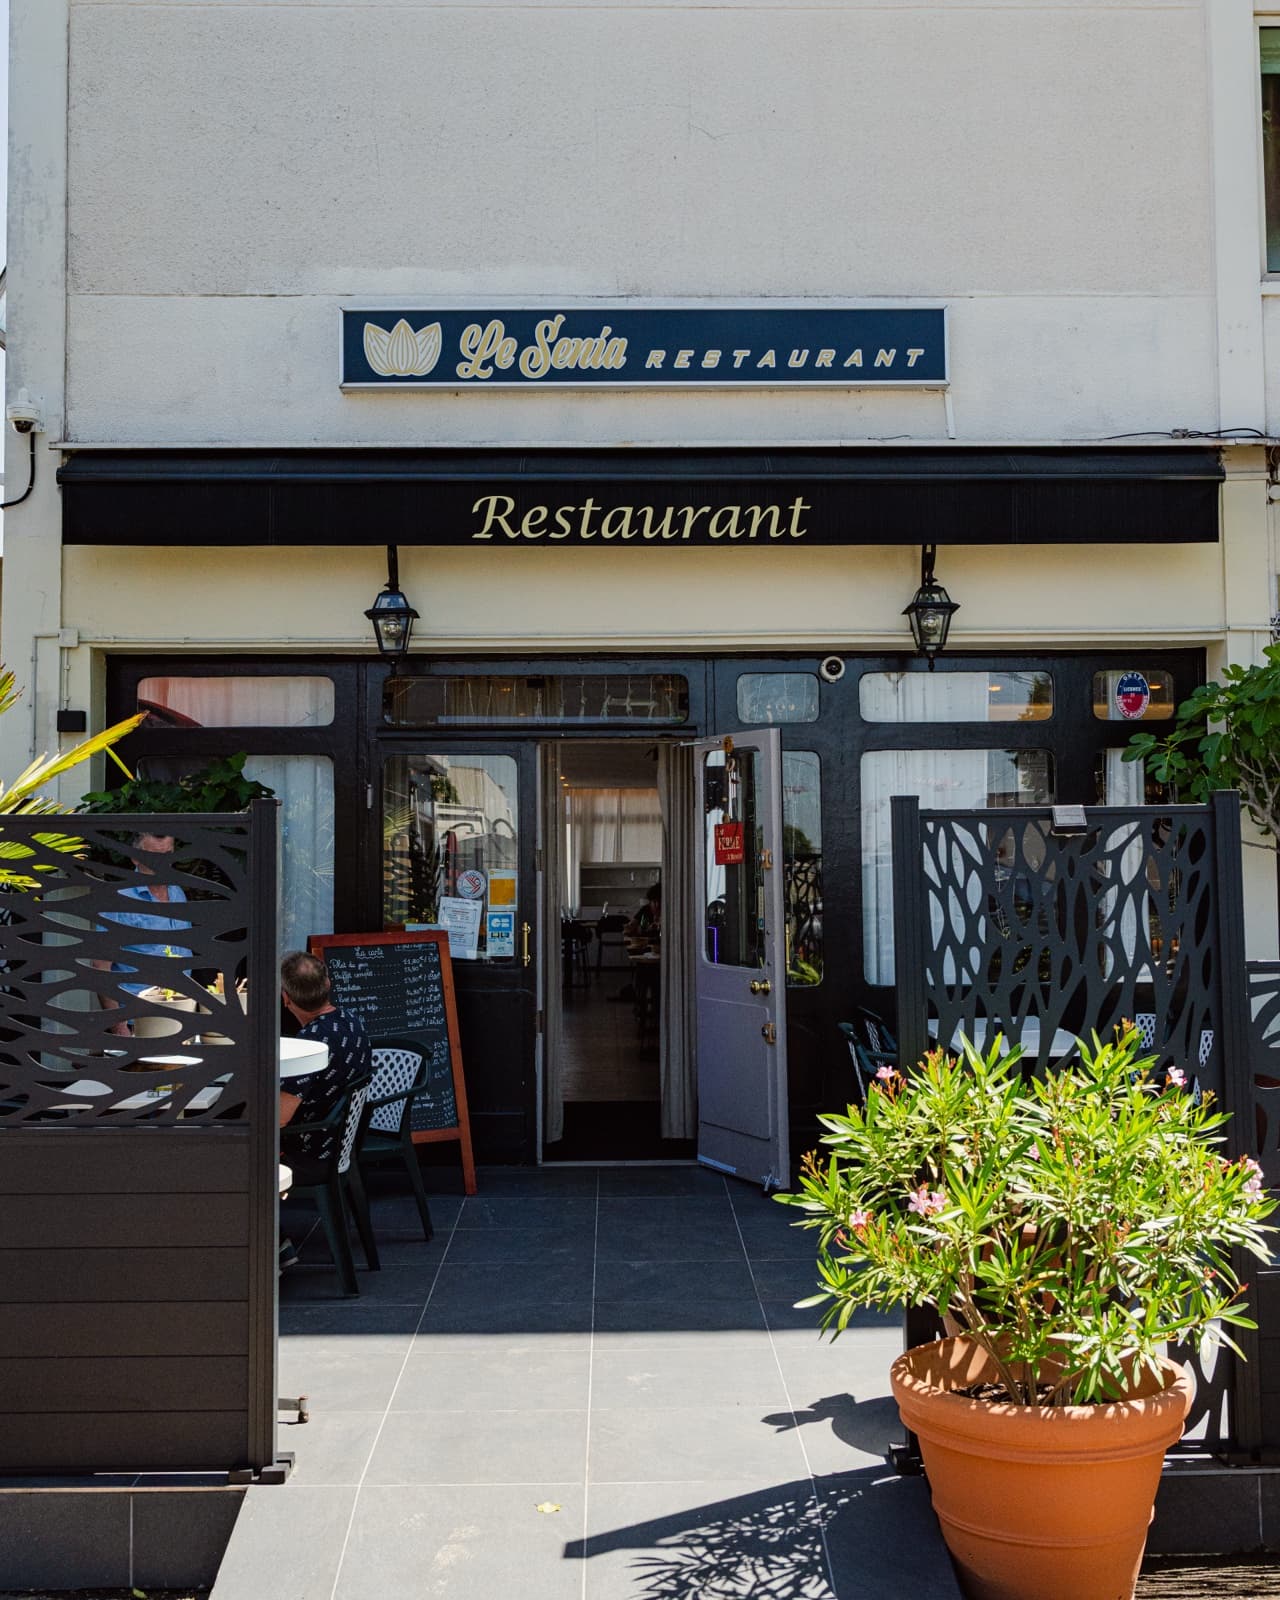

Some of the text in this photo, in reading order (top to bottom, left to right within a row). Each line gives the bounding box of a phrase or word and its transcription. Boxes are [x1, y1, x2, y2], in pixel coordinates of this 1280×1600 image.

[456, 319, 518, 379] Le
[646, 348, 925, 369] RESTAURANT
[472, 496, 811, 539] Restaurant
